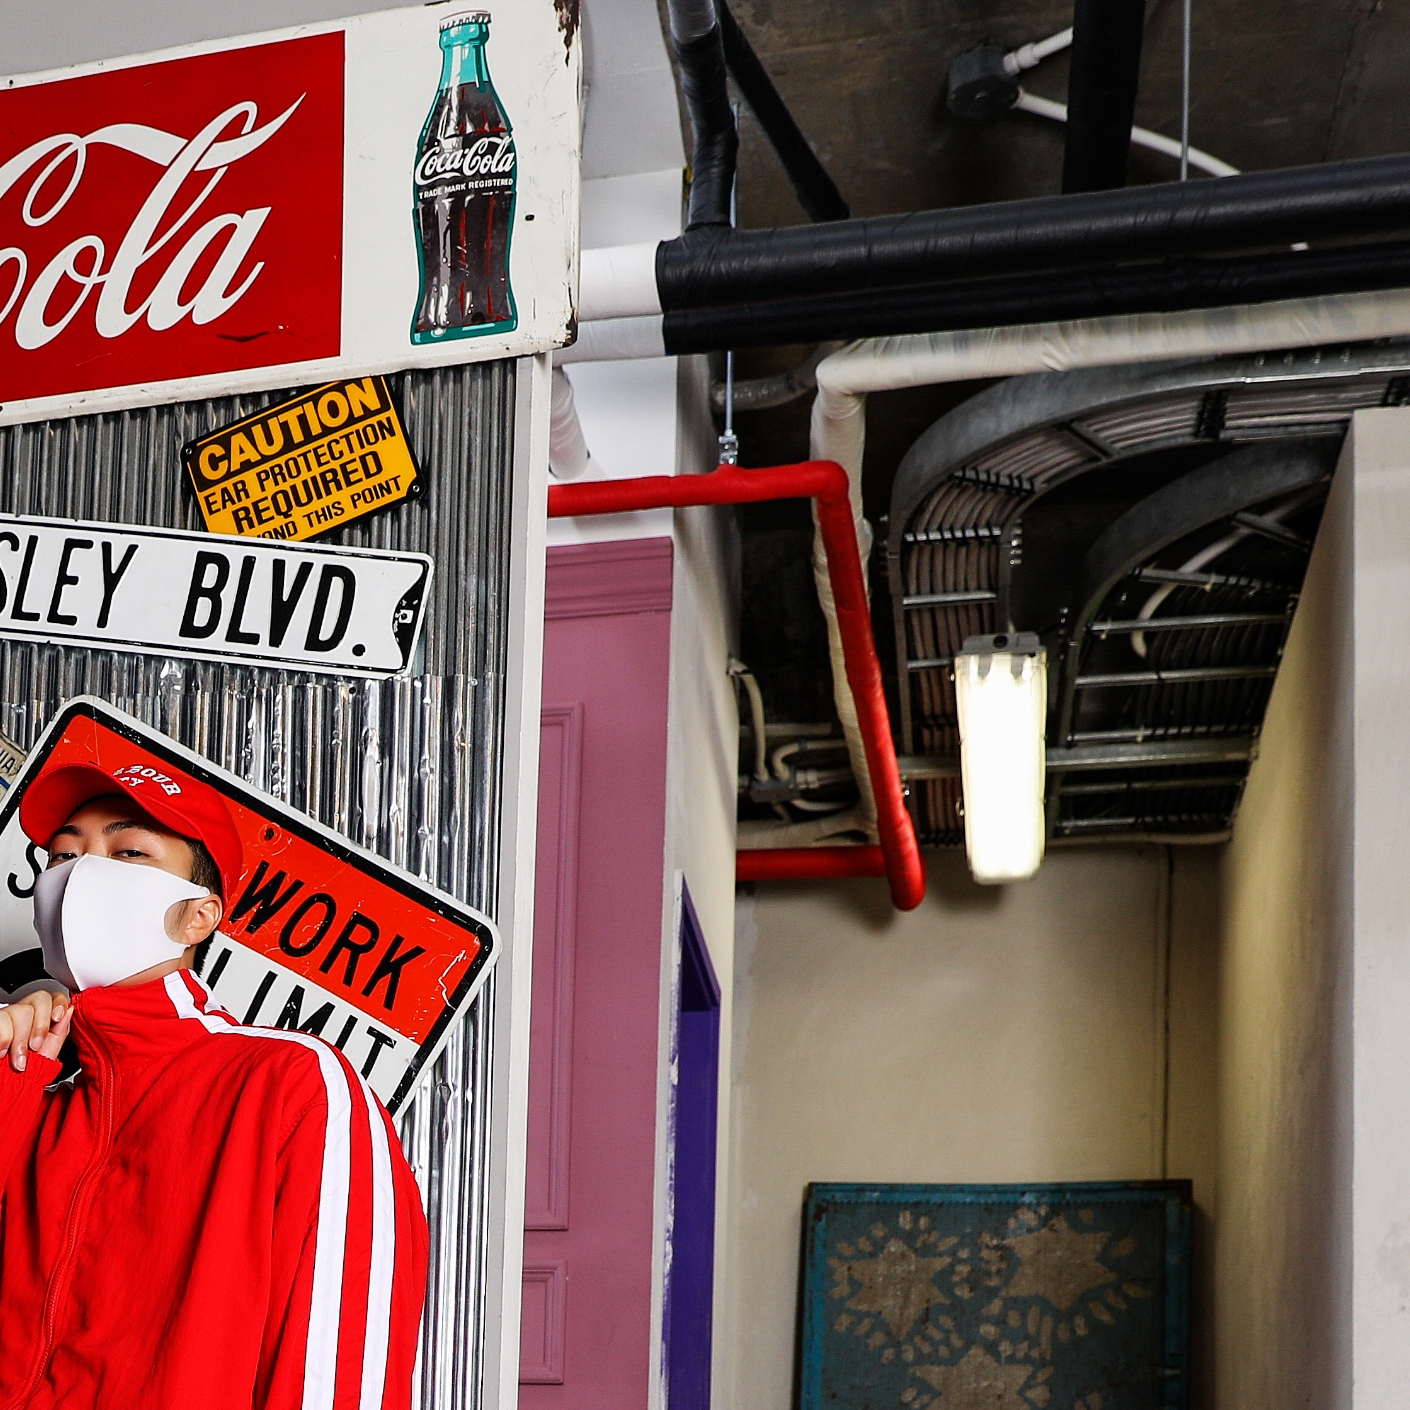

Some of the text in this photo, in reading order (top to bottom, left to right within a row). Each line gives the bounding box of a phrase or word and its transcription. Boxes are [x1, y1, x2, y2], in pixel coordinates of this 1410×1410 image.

[415, 136, 514, 185] Coca-Cola
[418, 178, 514, 199] TRADE MARK REGISTERED
[198, 377, 382, 481] CAUTION
[203, 415, 397, 516] EAR PROTECTION
[231, 449, 384, 534] REQUIRED
[256, 474, 402, 540] OND THIS POINT
[179, 550, 368, 657] BLVD.
[229, 860, 426, 1012] WORK
